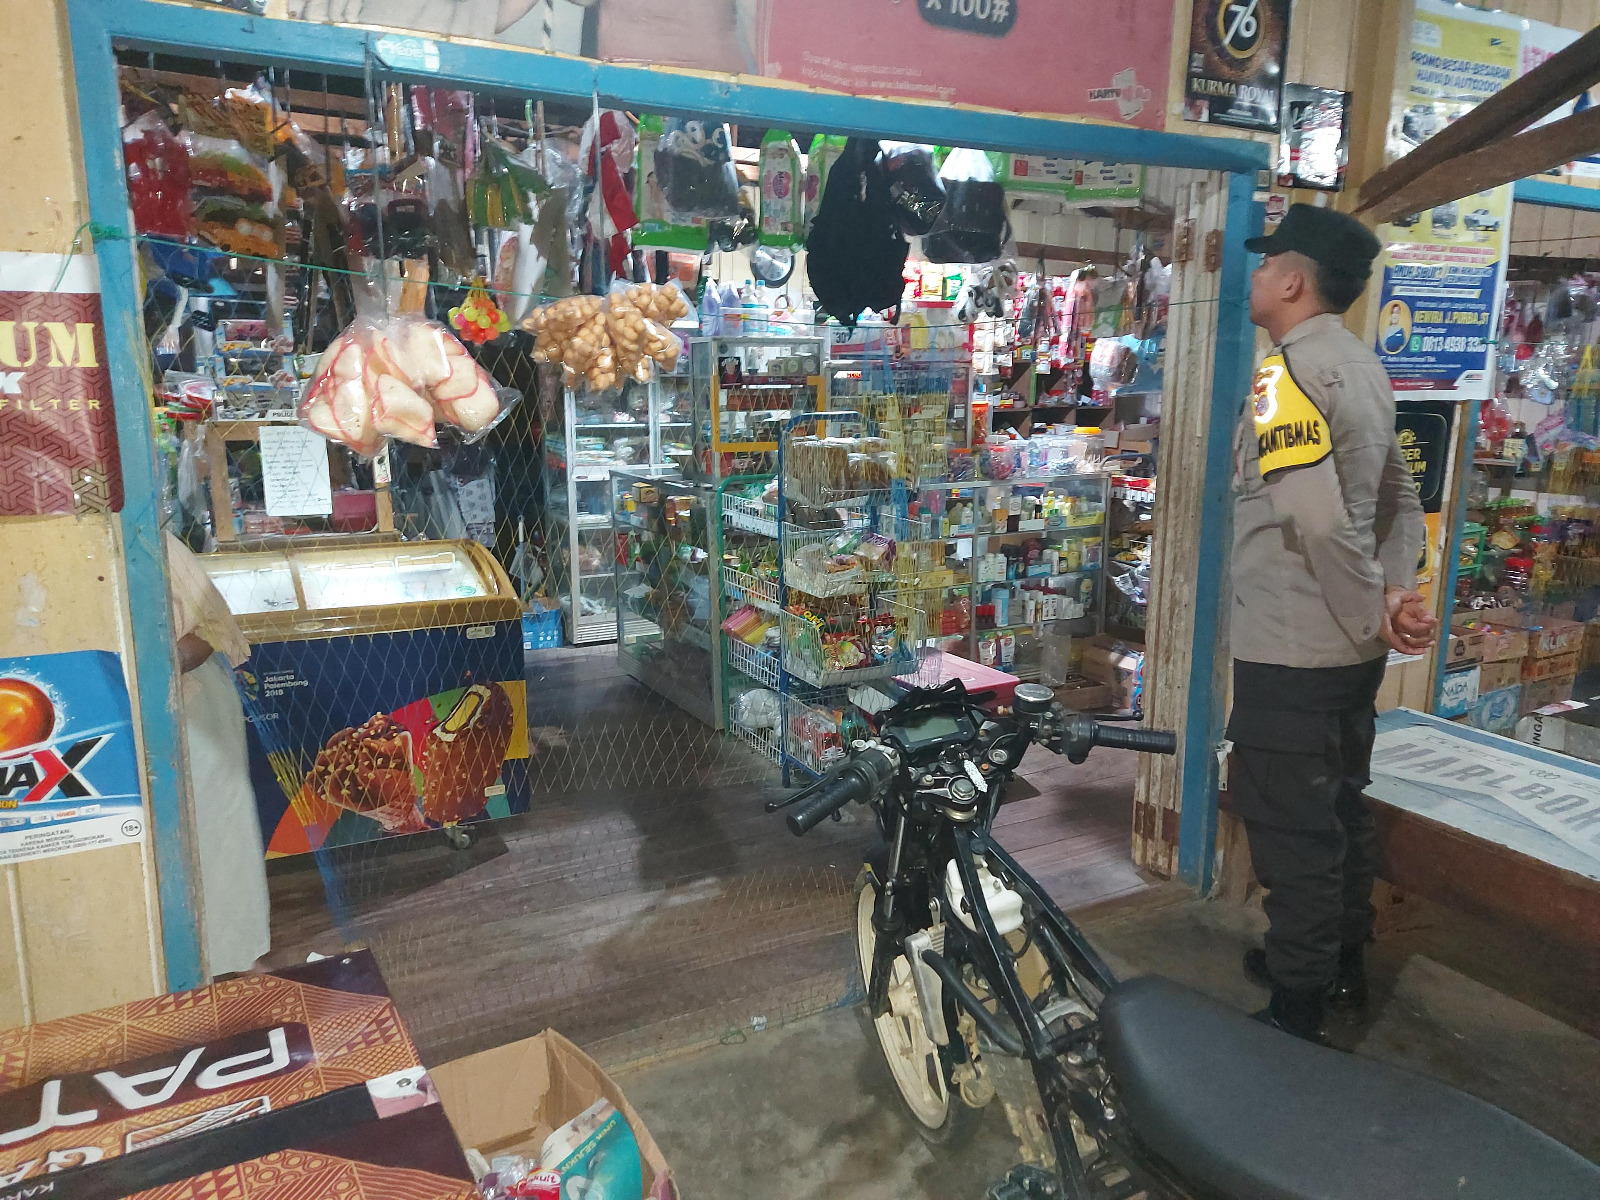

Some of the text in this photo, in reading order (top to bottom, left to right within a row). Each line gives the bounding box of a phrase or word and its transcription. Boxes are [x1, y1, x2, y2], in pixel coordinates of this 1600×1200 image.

[1221, 0, 1259, 46] 76
[1192, 78, 1238, 98] KURMA
[264, 674, 294, 682] Jakarta
[264, 680, 309, 690] Palembang
[264, 689, 284, 697] 2018
[560, 1141, 598, 1175] SEJUKN
